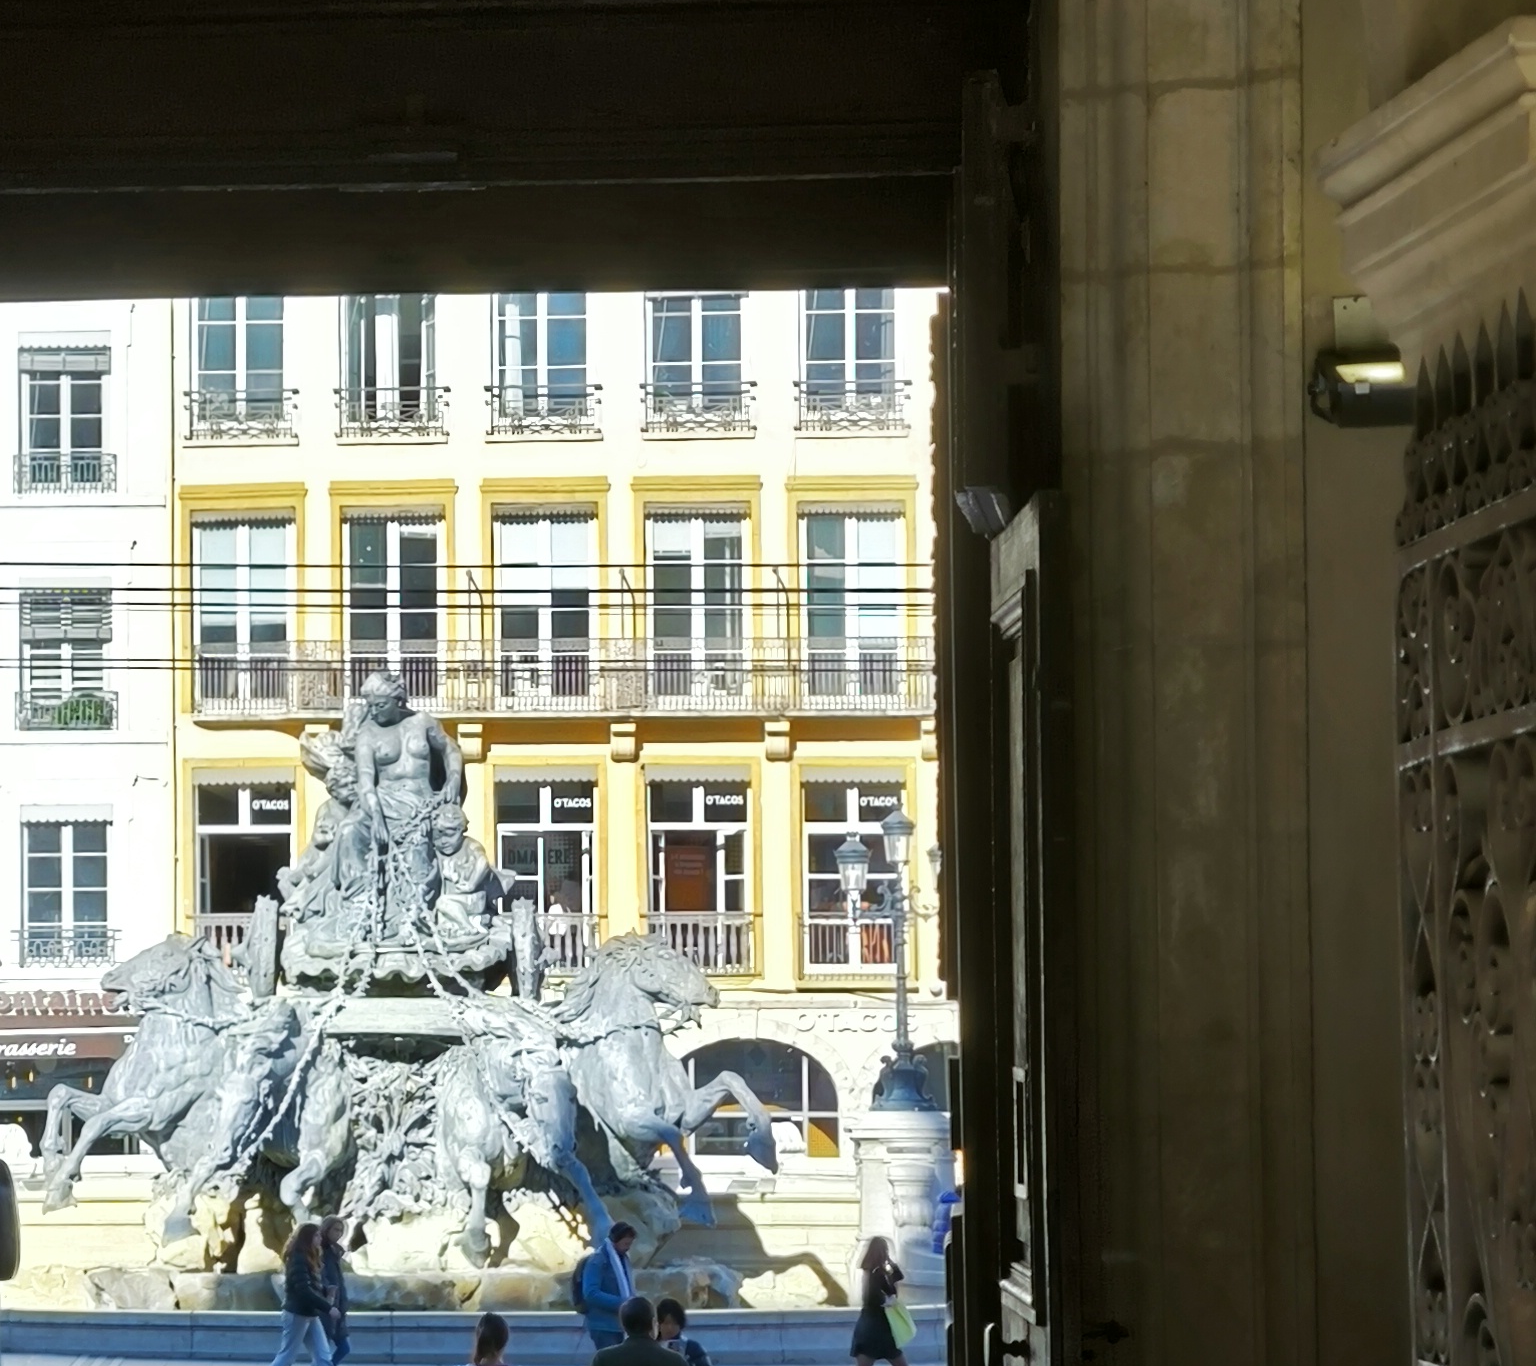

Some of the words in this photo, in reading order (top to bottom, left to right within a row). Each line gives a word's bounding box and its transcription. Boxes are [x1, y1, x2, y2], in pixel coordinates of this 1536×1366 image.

[252, 799, 289, 810] O'TACOS
[554, 797, 592, 808] O'TACOS
[706, 795, 744, 805] O'TACOS
